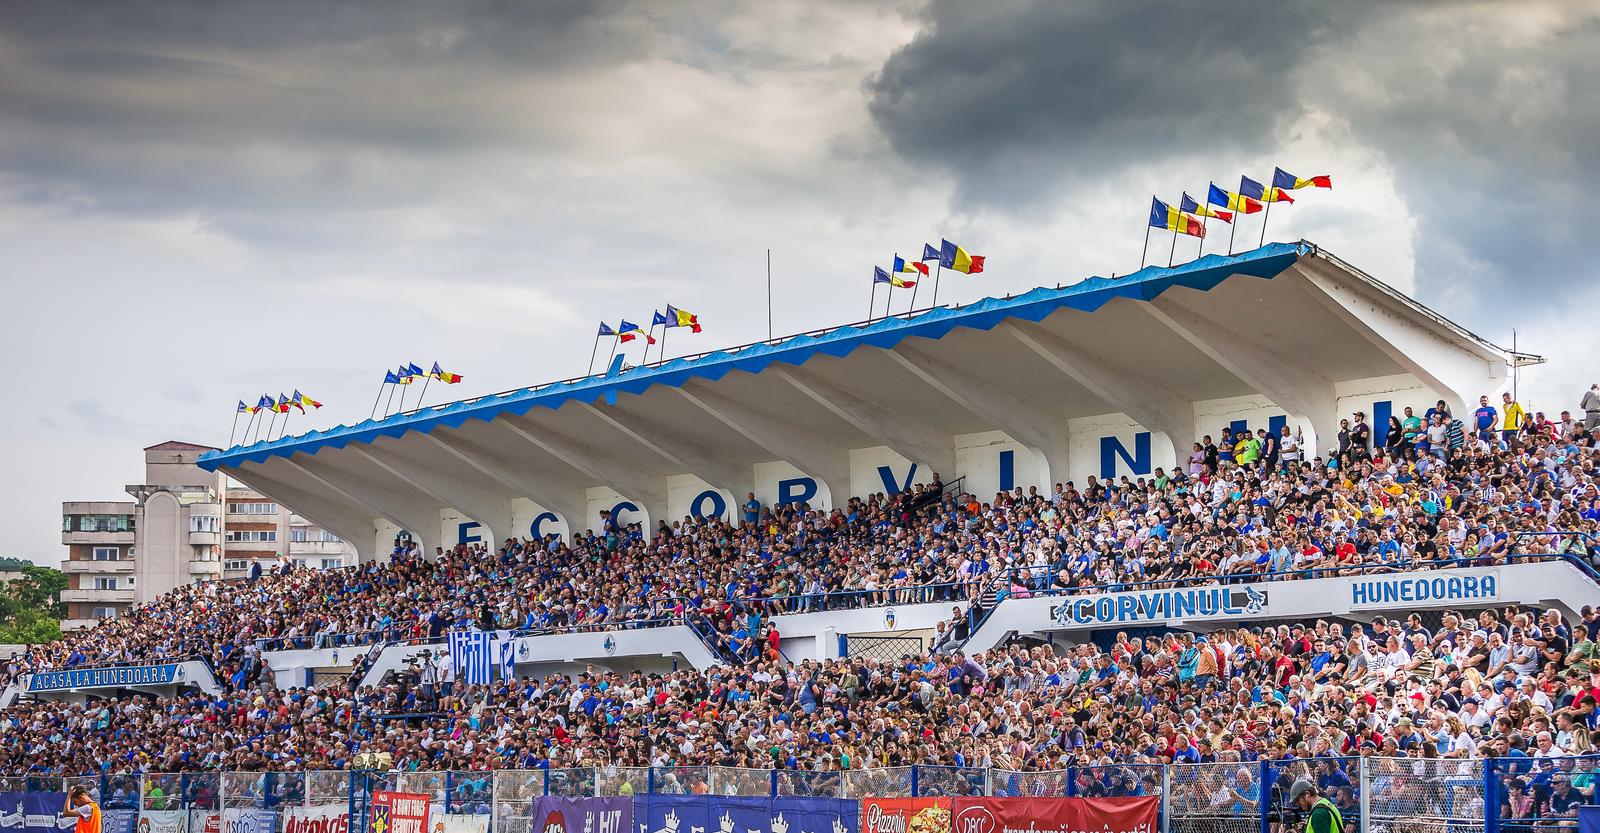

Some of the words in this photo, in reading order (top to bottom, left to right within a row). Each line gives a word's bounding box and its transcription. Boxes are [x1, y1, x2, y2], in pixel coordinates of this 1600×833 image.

[1352, 575, 1496, 604] HUNEDOARA
[1073, 588, 1243, 624] CORVINUL
[76, 673, 91, 687] LA
[95, 667, 168, 686] HUNEDOARA
